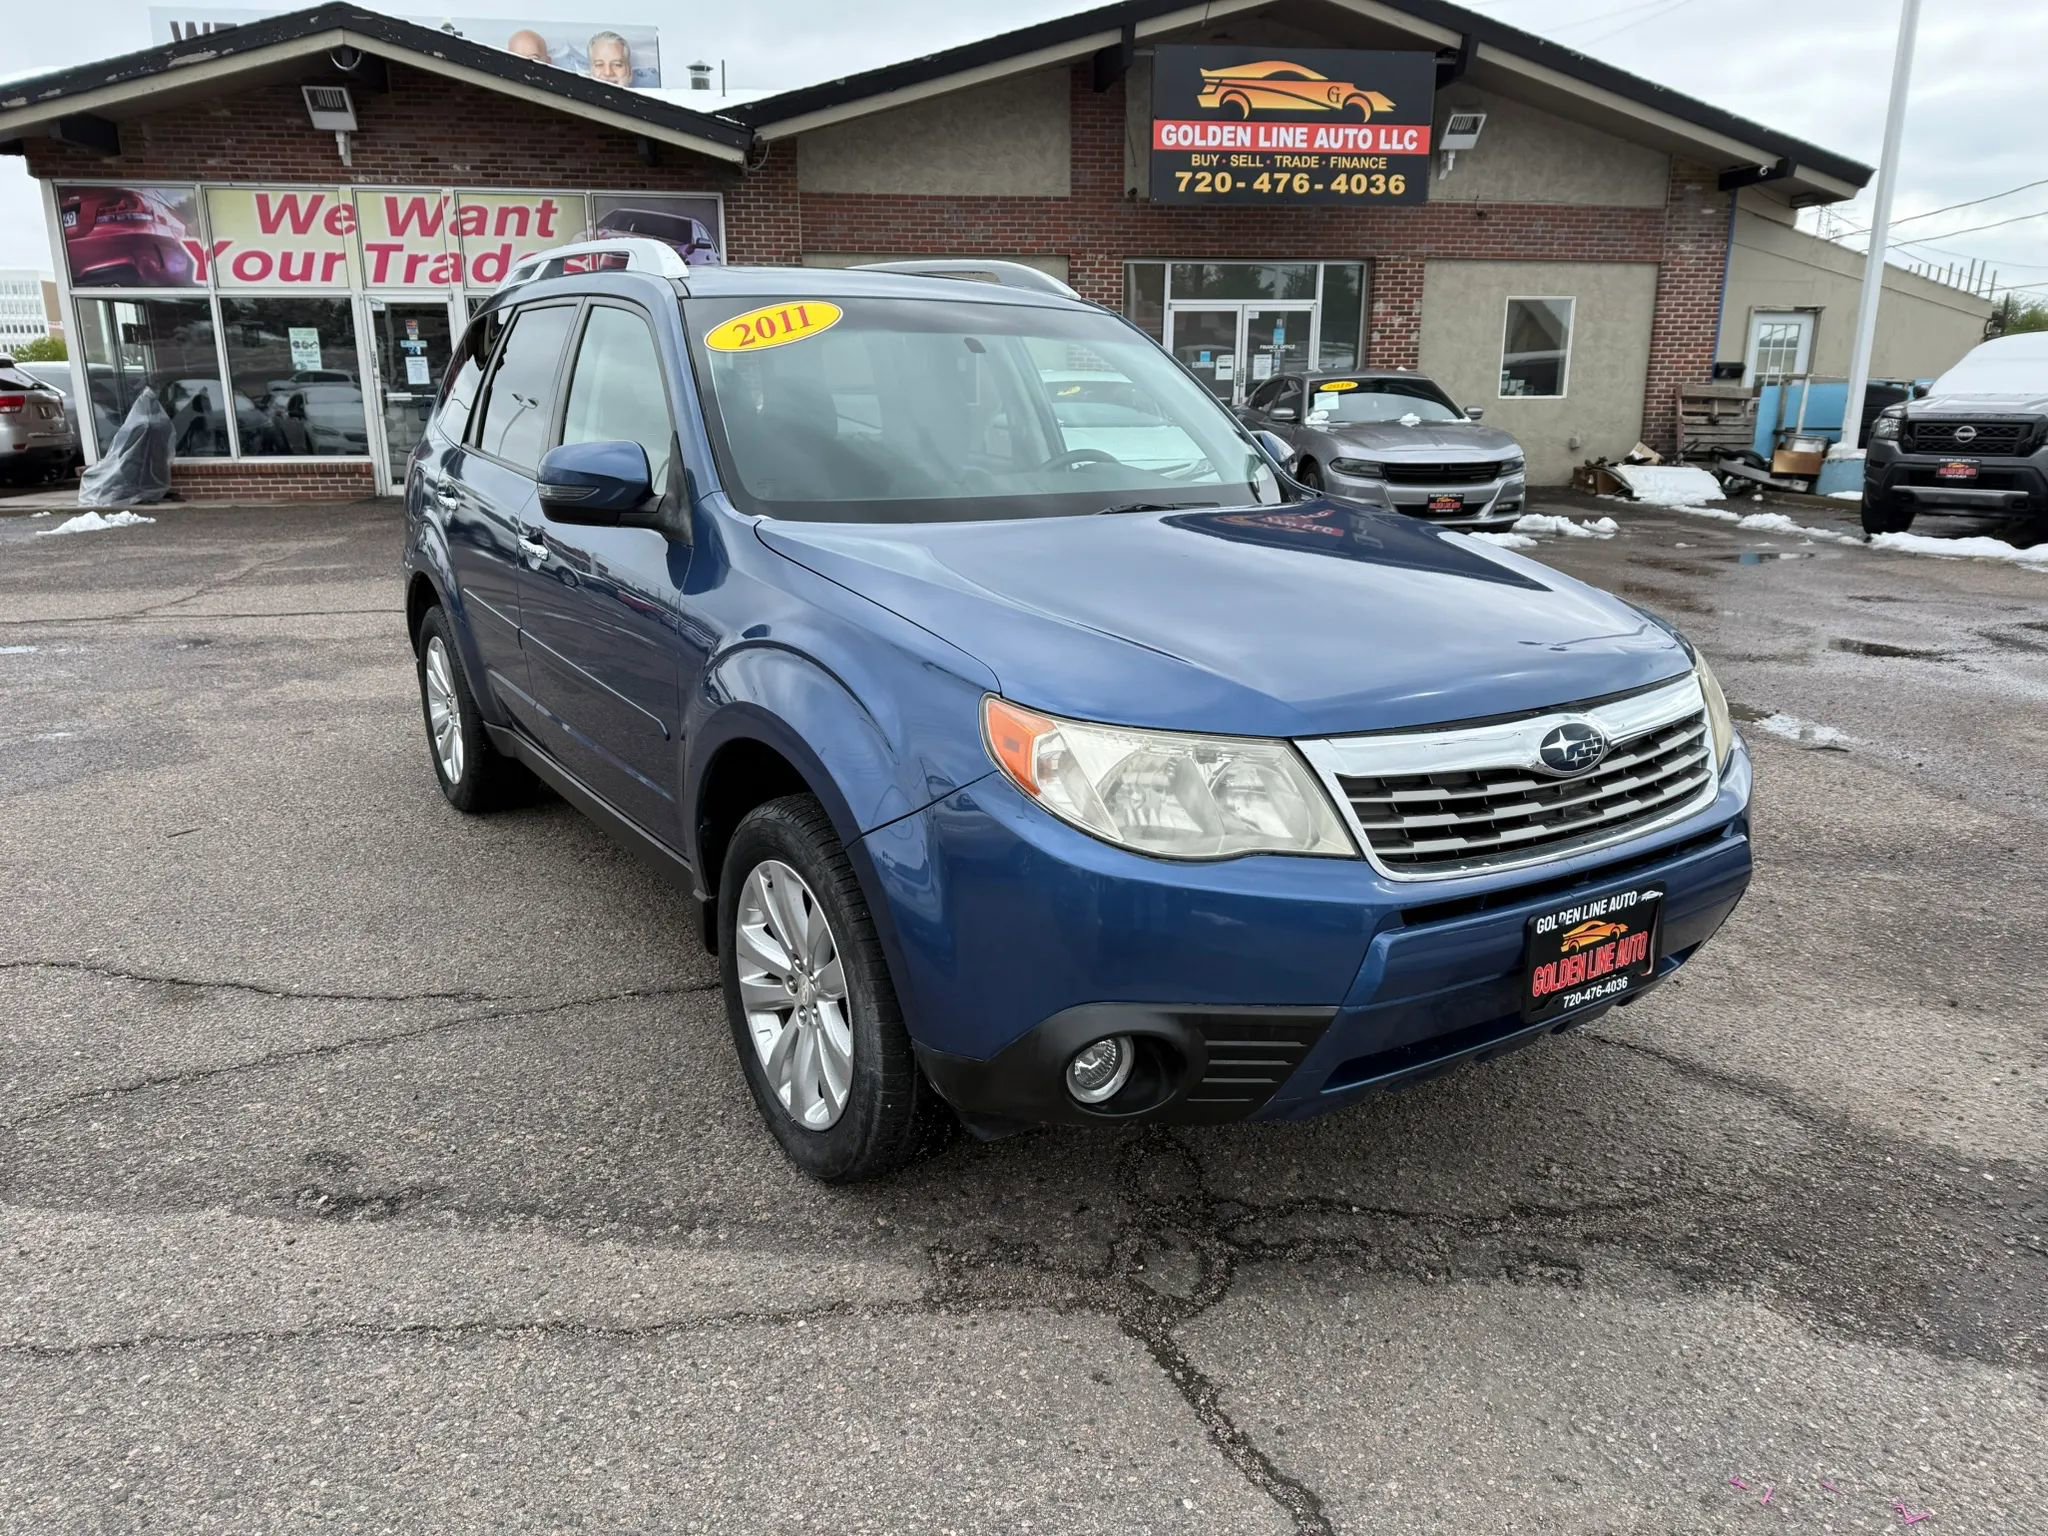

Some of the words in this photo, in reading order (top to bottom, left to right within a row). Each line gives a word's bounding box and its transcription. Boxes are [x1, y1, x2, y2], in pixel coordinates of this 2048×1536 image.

[1161, 124, 1251, 148] GOLDEN
[1258, 127, 1308, 149] LINE
[1314, 128, 1373, 150] AUTO
[1379, 129, 1418, 151] LLC
[1191, 154, 1219, 167] BUY
[1230, 155, 1264, 168] SELL
[1275, 156, 1319, 169] TRADE
[1330, 157, 1387, 170] FINANCE
[255, 193, 355, 237] We
[383, 195, 559, 238] Want
[182, 240, 347, 283] Your
[732, 305, 814, 347] 2011
[1536, 909, 1581, 935] GOLDEN
[1582, 899, 1608, 920] LINE
[1608, 890, 1638, 913] AUTO
[1532, 951, 1587, 998] GOLDEN
[1586, 942, 1617, 981] LINE
[1616, 930, 1649, 969] AUTO
[1563, 976, 1629, 1009] 720-476-4036
